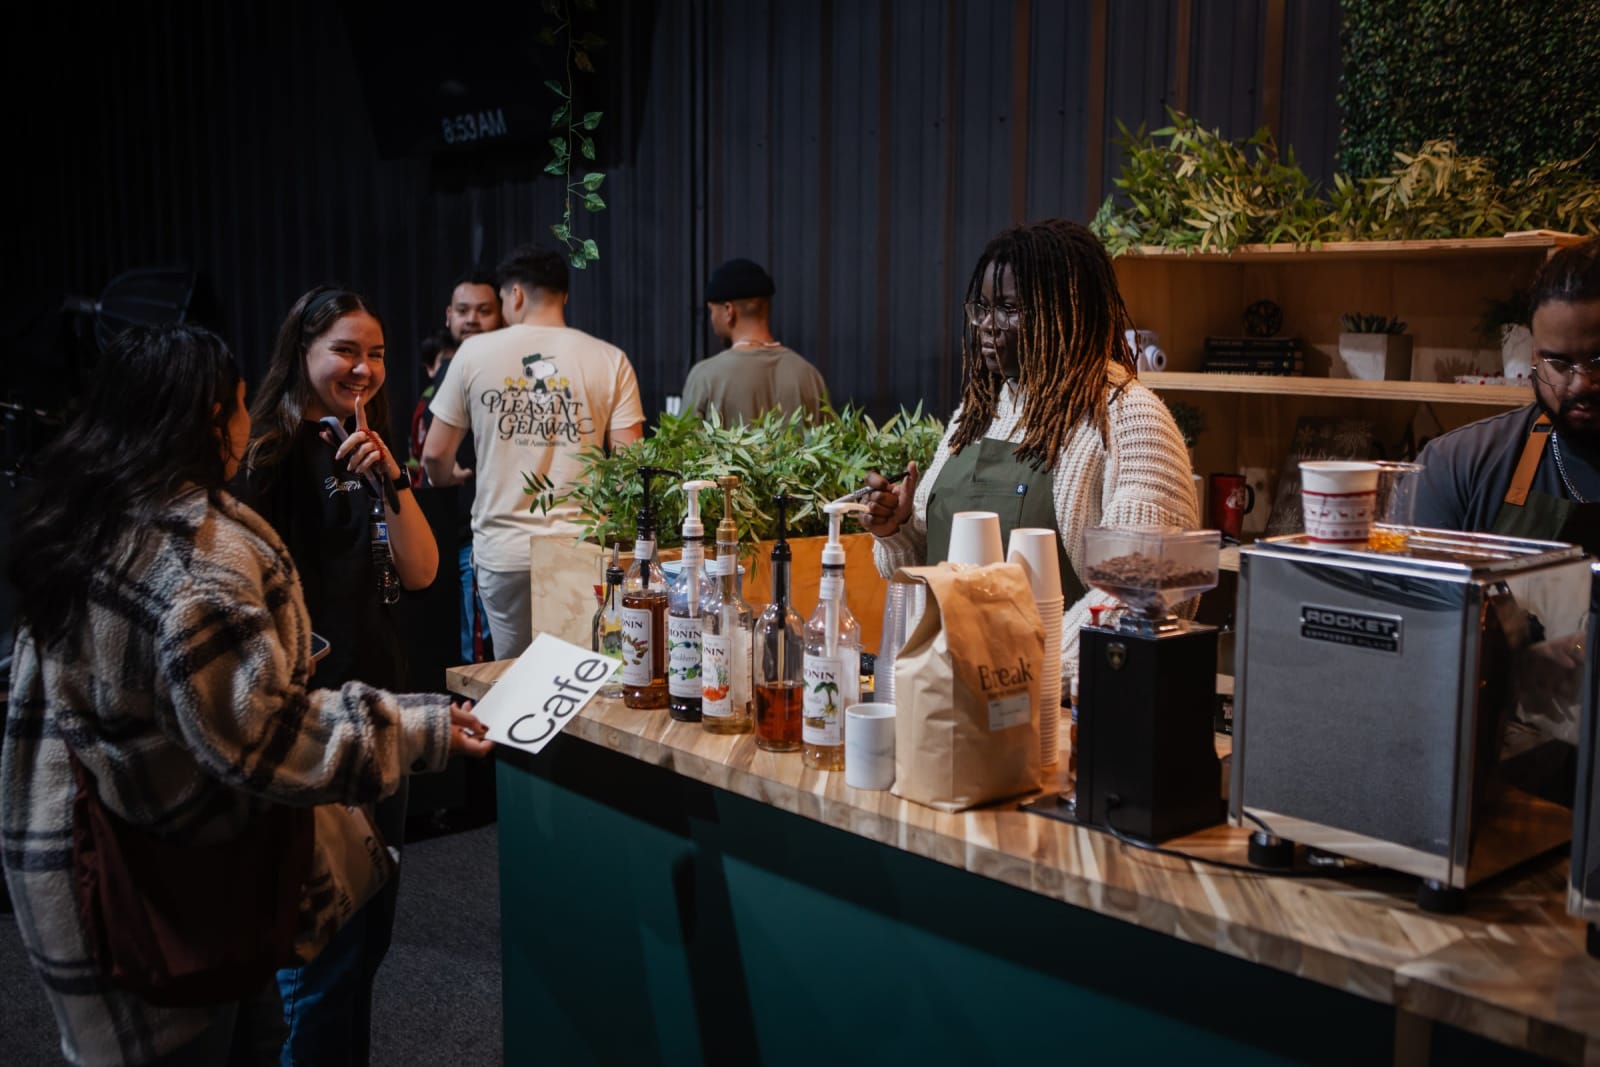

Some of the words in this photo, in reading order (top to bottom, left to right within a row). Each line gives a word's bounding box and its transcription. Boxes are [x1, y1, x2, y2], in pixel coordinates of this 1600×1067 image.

[481, 389, 583, 418] PLEASANT
[498, 413, 596, 444] GETAWAY
[1306, 610, 1394, 633] ROCKET
[978, 657, 1034, 691] Break
[507, 658, 609, 744] Cafe
